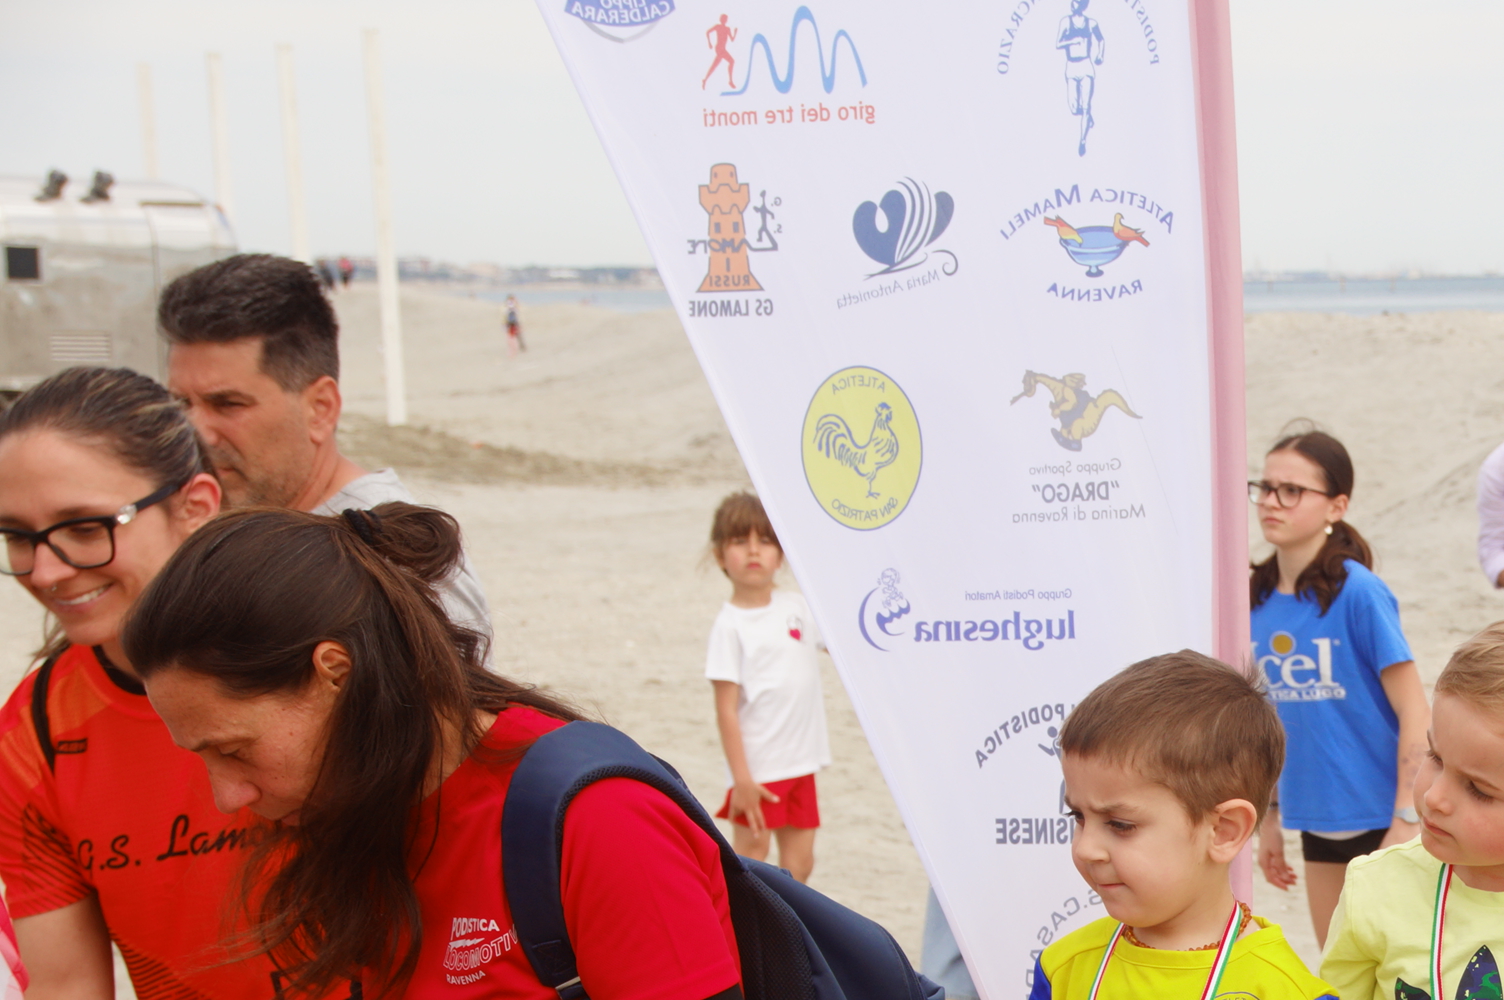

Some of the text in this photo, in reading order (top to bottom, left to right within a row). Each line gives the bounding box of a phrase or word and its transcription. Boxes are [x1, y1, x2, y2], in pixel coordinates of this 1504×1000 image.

[1301, 688, 1347, 700] LUGO
[156, 814, 249, 862] Lam
[443, 924, 519, 971] LOCOMOTIV
[446, 970, 486, 985] RAVENNA
